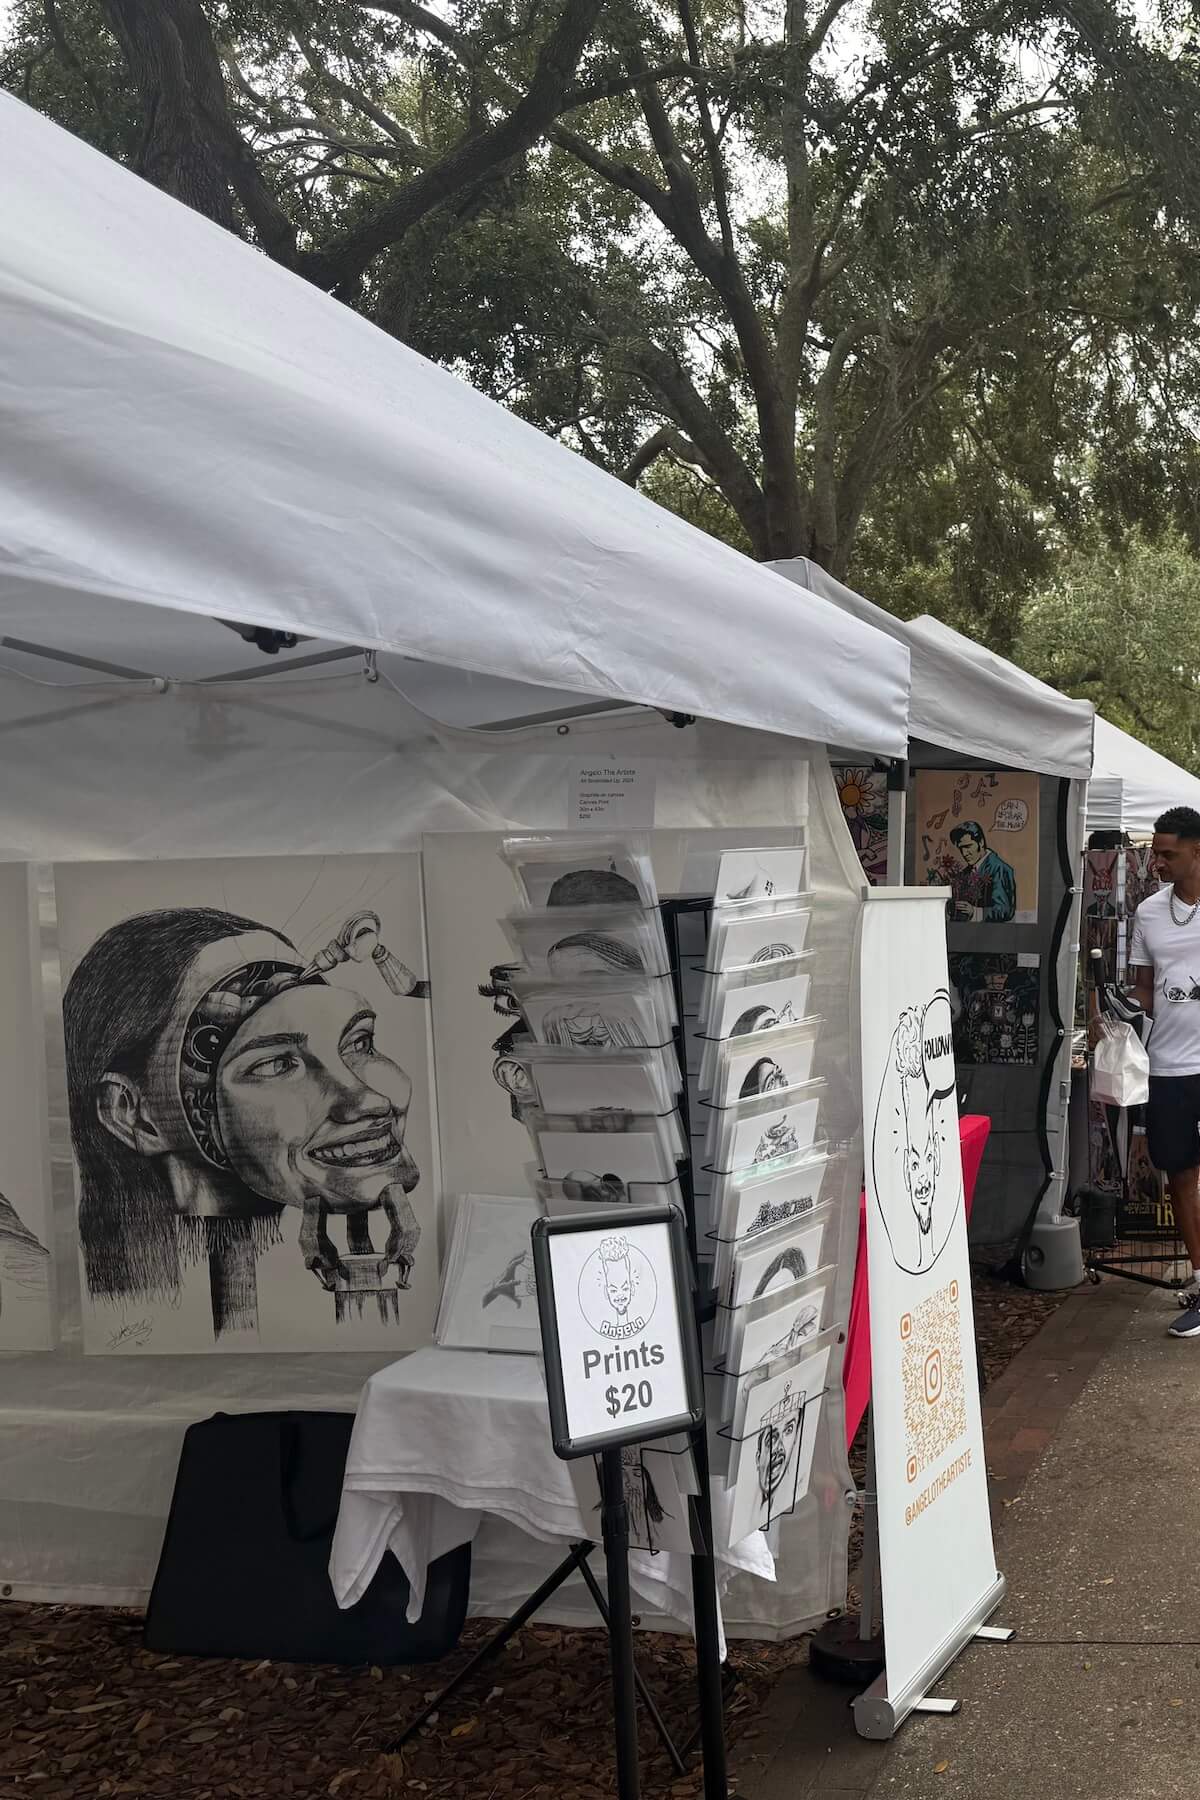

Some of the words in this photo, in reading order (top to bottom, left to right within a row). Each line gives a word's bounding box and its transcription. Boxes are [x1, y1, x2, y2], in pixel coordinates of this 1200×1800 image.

[583, 1340, 665, 1379] Prints
[605, 1379, 653, 1419] $20
[905, 1447, 973, 1526] @ANGELOTHEARTISTE
